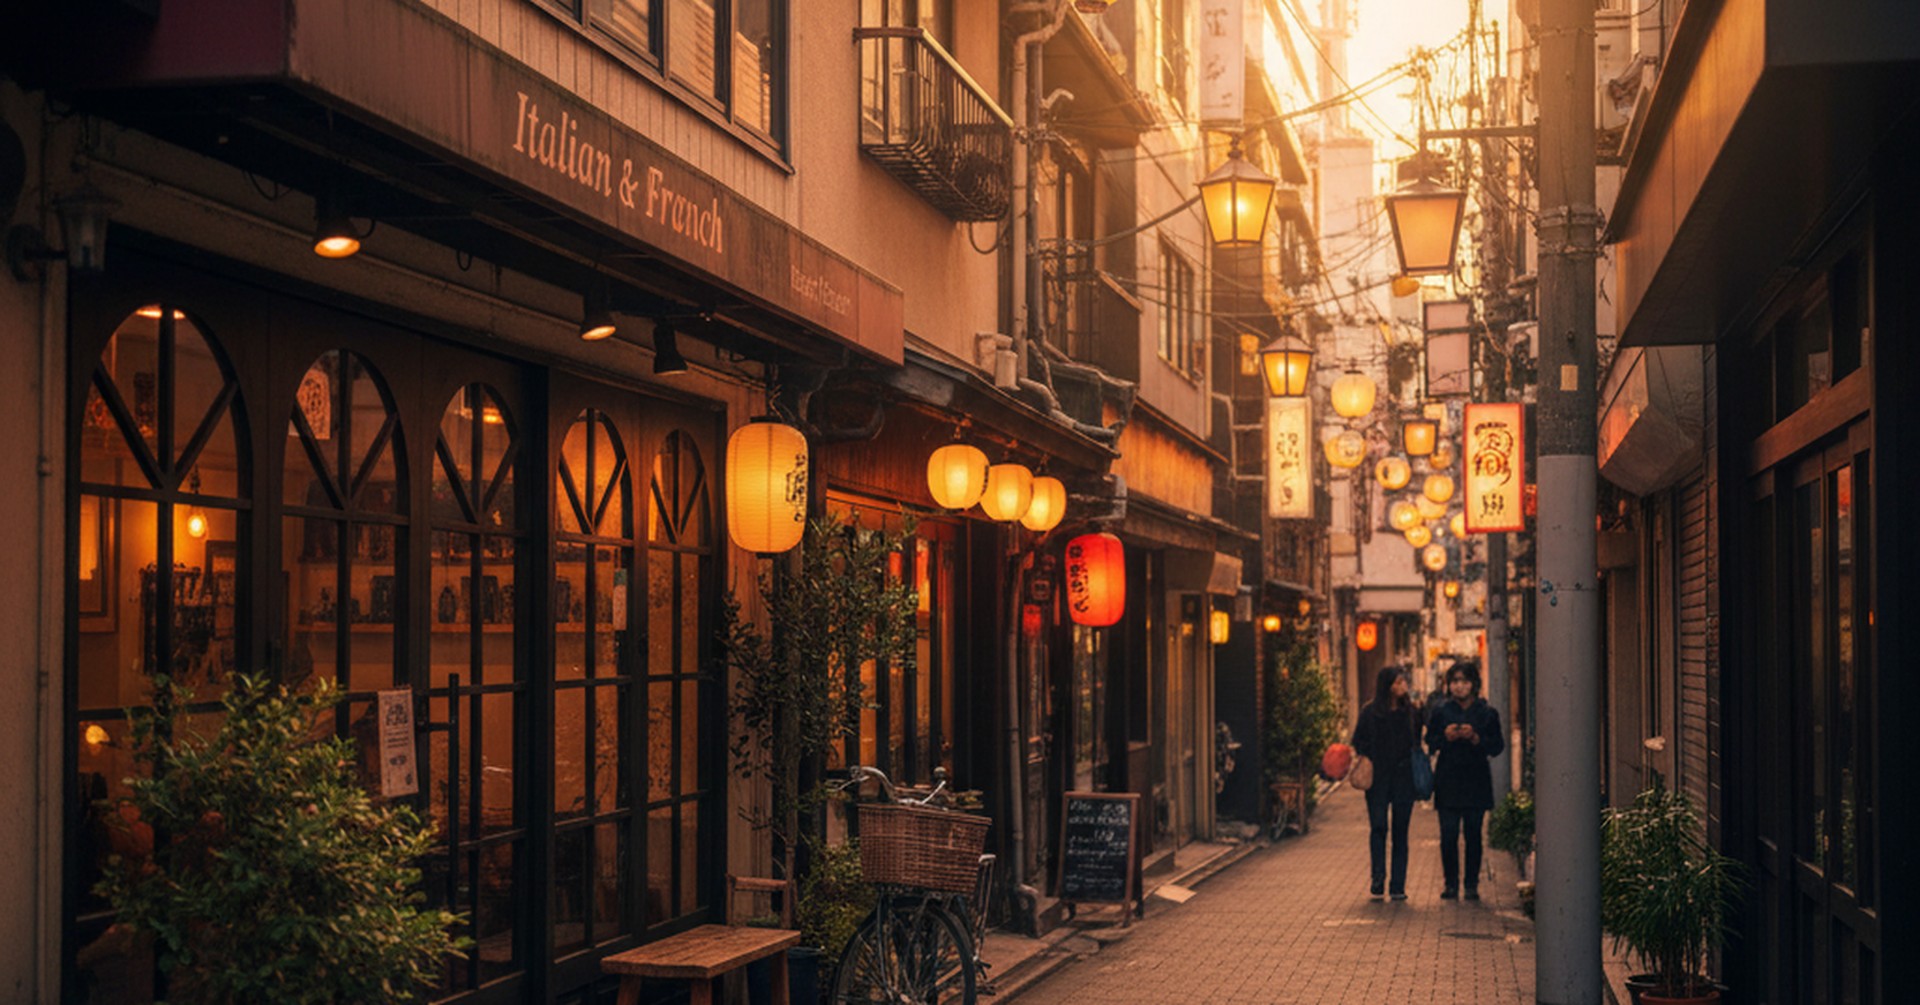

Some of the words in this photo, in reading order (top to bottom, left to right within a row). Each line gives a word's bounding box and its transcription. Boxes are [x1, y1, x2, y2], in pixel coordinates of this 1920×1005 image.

[513, 91, 612, 197] Italian
[619, 159, 638, 209] &
[646, 166, 723, 253] Franch
